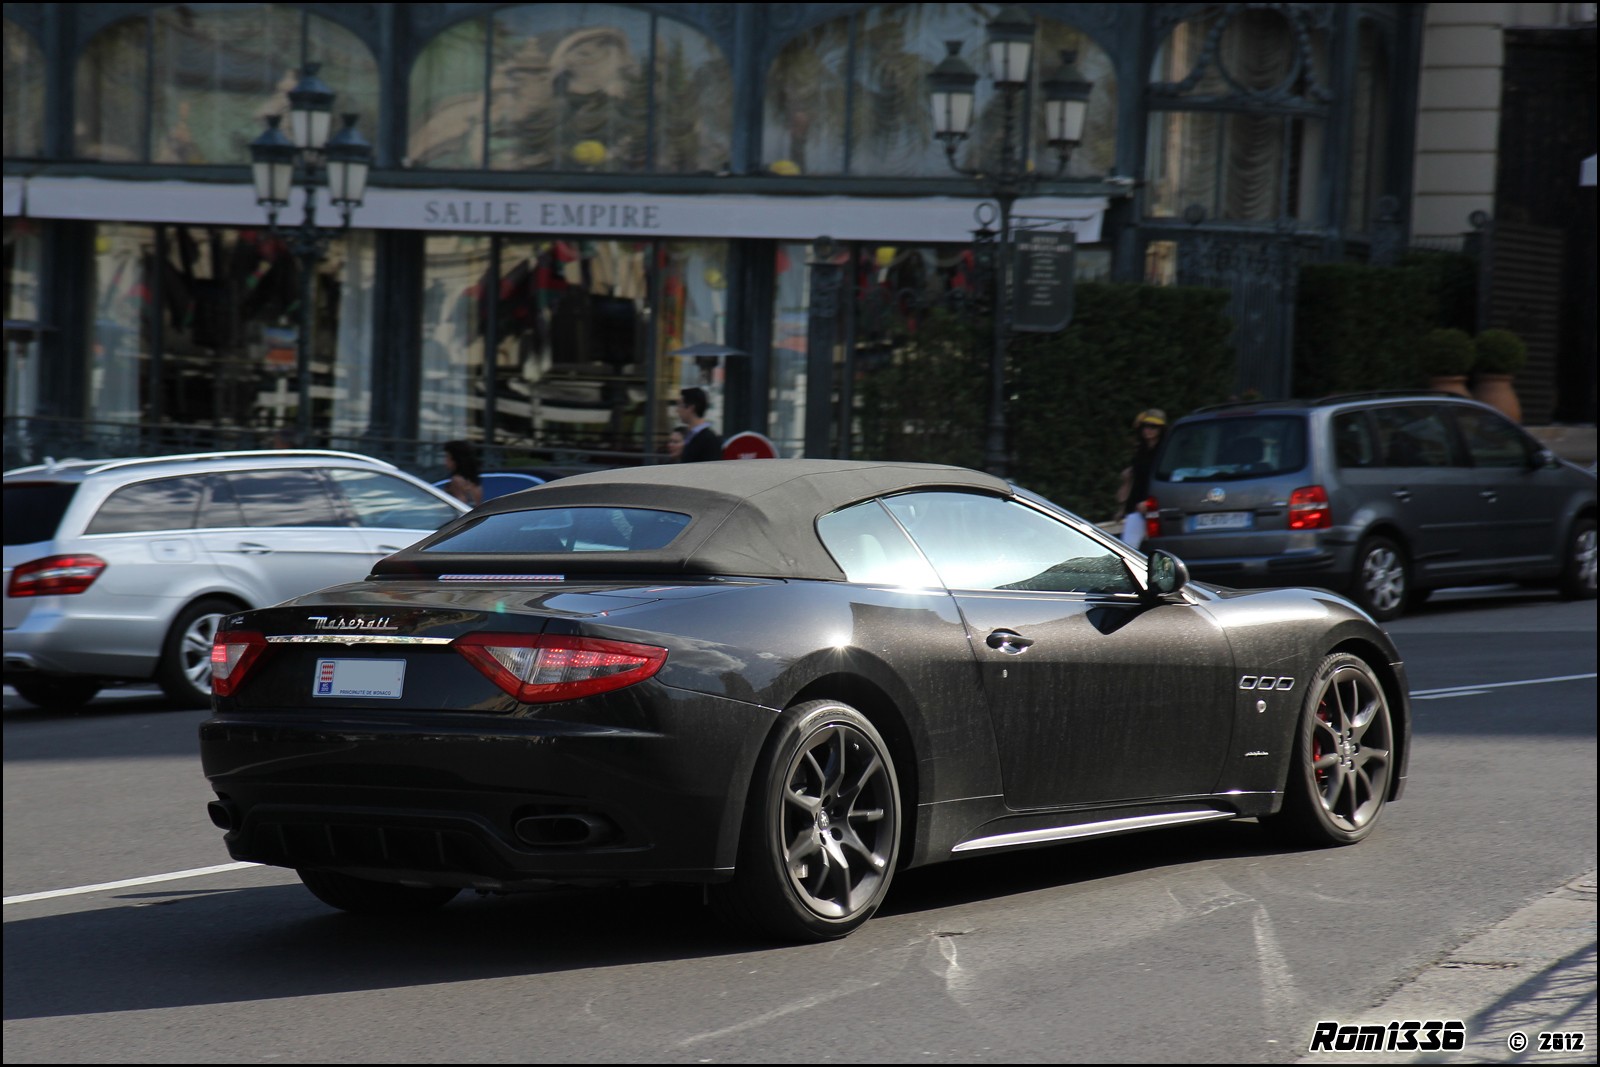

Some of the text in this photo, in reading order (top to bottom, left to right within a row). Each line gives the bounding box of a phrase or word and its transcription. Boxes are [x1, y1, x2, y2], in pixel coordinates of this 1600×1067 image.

[424, 200, 661, 229] SALLE EMPIRE
[308, 616, 398, 630] Maserati
